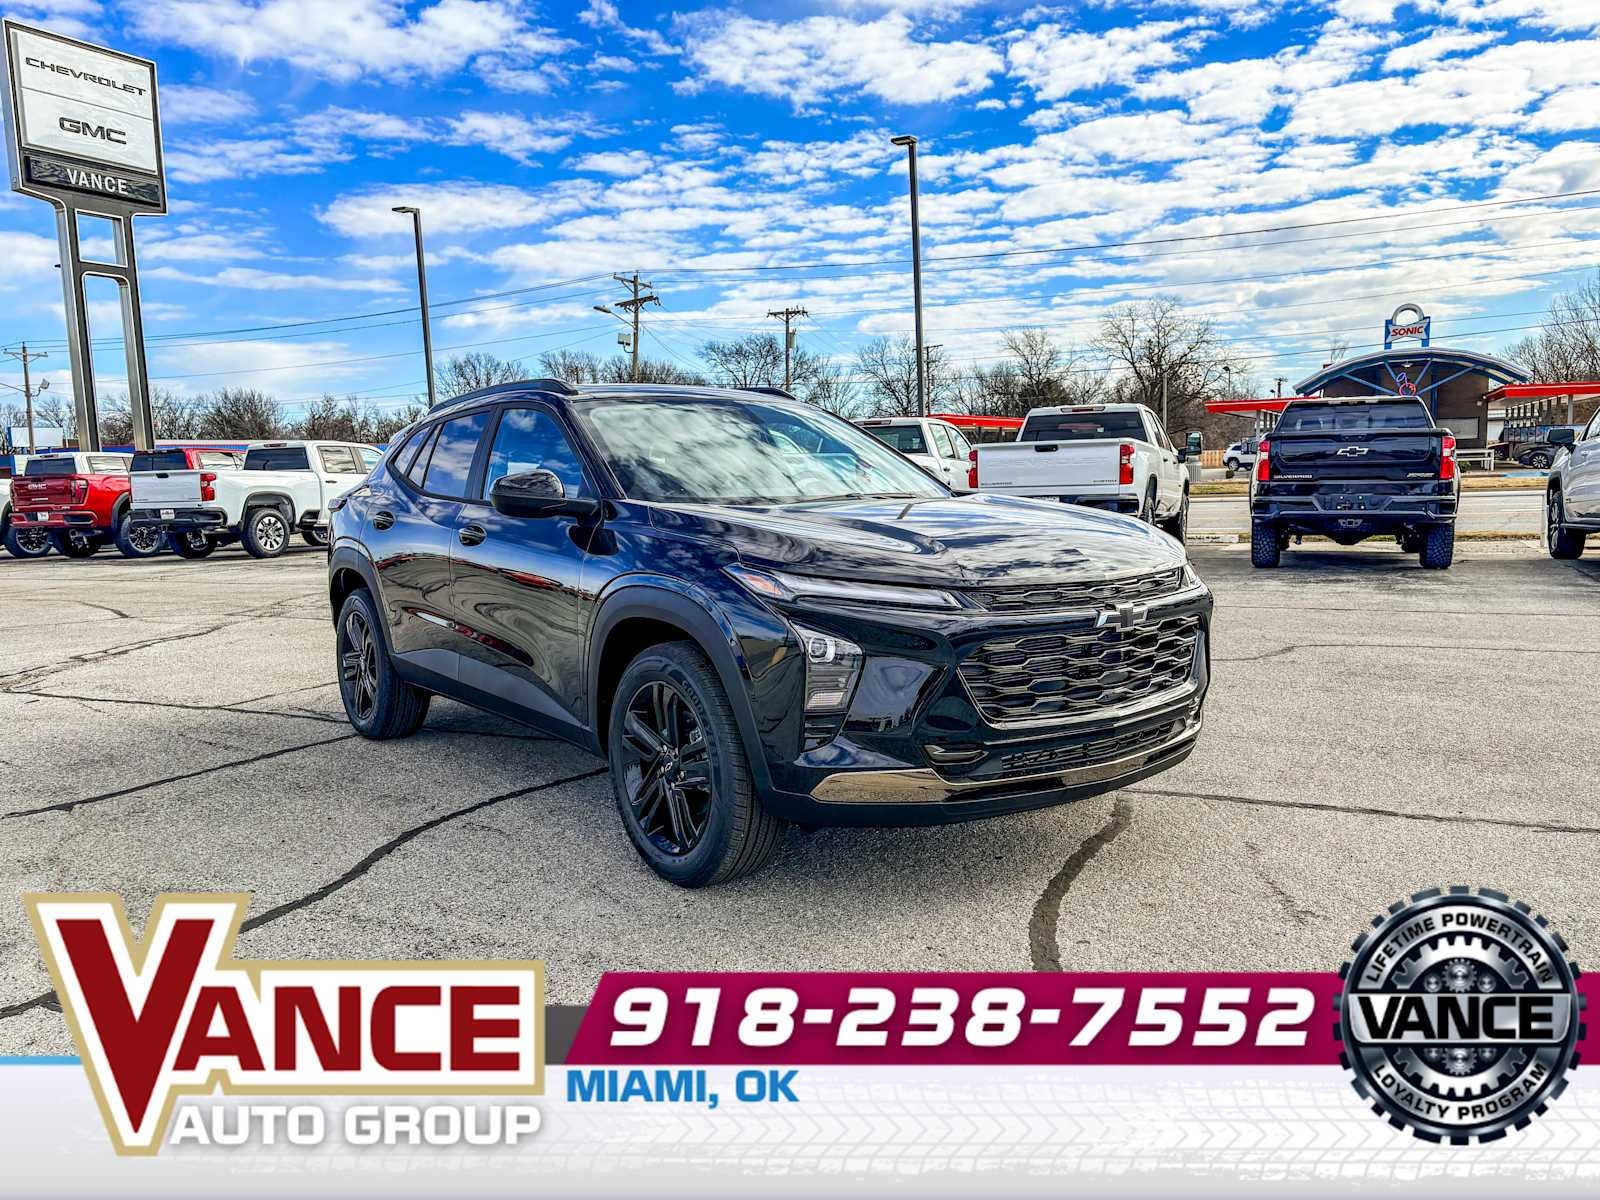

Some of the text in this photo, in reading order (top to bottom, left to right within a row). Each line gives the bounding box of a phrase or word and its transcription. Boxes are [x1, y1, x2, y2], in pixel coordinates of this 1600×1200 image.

[25, 56, 146, 96] CHEVROLET
[59, 116, 127, 145] GMC
[66, 168, 129, 195] VANCE
[1391, 325, 1424, 336] SONIC
